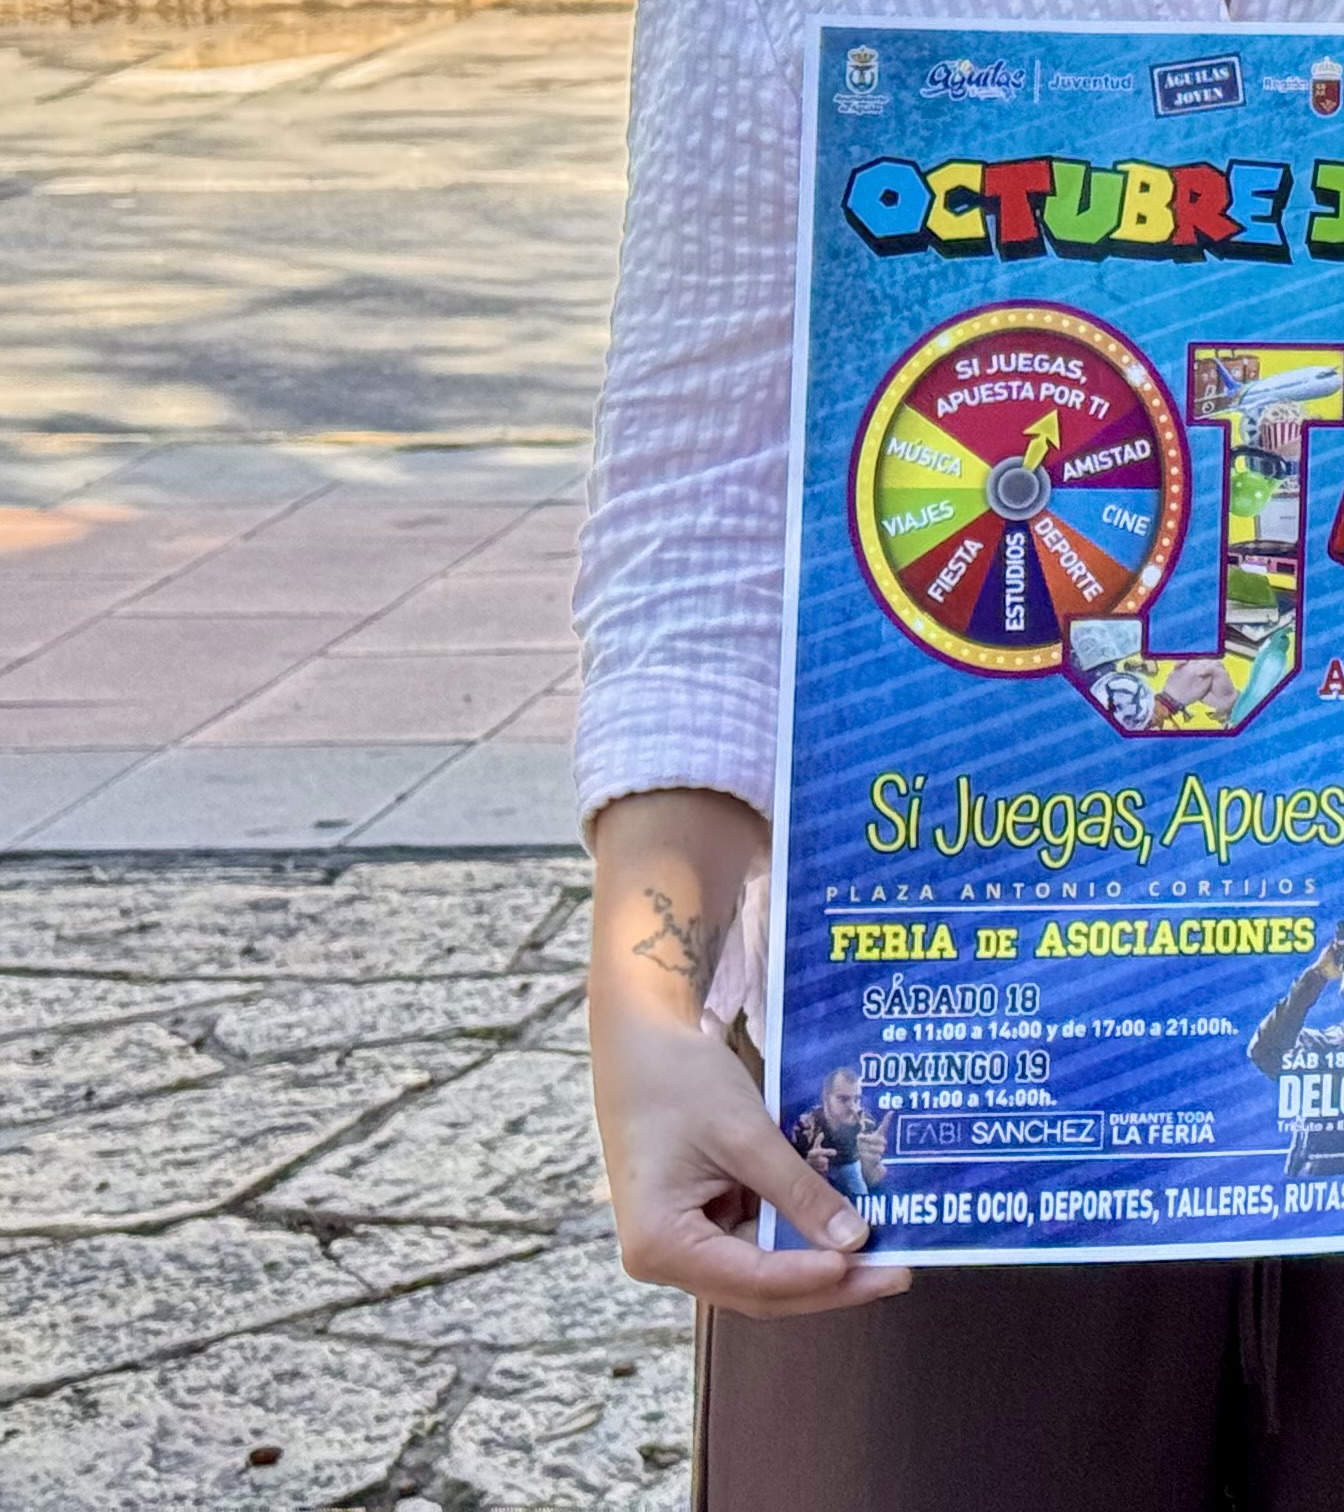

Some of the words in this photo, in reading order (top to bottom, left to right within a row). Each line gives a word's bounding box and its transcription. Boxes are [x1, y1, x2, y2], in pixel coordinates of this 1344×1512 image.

[1174, 87, 1224, 106] JOVEN
[842, 155, 1295, 265] OCTUBRE
[955, 359, 980, 380] SI
[986, 353, 1088, 384] JUEGAS,
[936, 382, 1034, 418] APUESTA
[1039, 382, 1085, 410] POR
[1090, 396, 1109, 419] TI
[886, 437, 962, 477] MÚSICA
[1062, 440, 1151, 482] AMISTAD
[882, 500, 954, 538] VIAJES
[1102, 504, 1151, 537] CINE
[928, 538, 984, 603] FIESTA
[1034, 518, 1103, 603] DEPORTE
[1004, 532, 1026, 631] ESTUDIOS
[866, 771, 926, 854] Si
[934, 772, 1154, 869] Juegas,
[826, 884, 935, 903] PLAZA
[961, 880, 1123, 901] ANTONIO
[1148, 877, 1317, 898] CORTIJOS
[829, 922, 958, 962] FERIA
[975, 928, 1018, 960] DE
[1034, 917, 1316, 959] ASOCIACIONES
[862, 972, 999, 1018] SÁBADO
[1004, 982, 1041, 1016] 18
[882, 1024, 907, 1042] de
[913, 1023, 966, 1041] 11:00
[971, 1025, 982, 1040] a
[989, 1023, 1042, 1040] 14:00
[1046, 1024, 1058, 1043] y
[1062, 1021, 1086, 1039] de
[1093, 1019, 1145, 1038] 17:00
[1149, 1023, 1162, 1037] a
[1166, 1017, 1239, 1037] 21:00h.
[861, 1052, 1008, 1088] DOMINGO
[1014, 1049, 1050, 1083] 19
[878, 1090, 904, 1110] de
[909, 1089, 963, 1109] 11:00
[968, 1093, 979, 1108] a
[985, 1088, 1057, 1108] 14:00h.
[1110, 1112, 1175, 1125] DURANTE
[1177, 1111, 1215, 1124] TODA
[906, 1119, 961, 1145] FABI
[970, 1118, 1097, 1145] SANCHEZ
[1111, 1126, 1140, 1145] LA
[1148, 1124, 1216, 1145] FERIA
[856, 1195, 887, 1226] UN
[891, 1194, 937, 1224] MES
[943, 1193, 972, 1223] DE
[977, 1192, 1034, 1227] OCIO,
[1039, 1188, 1160, 1225] DEPORTES,
[1165, 1185, 1279, 1219] TALLERES,
